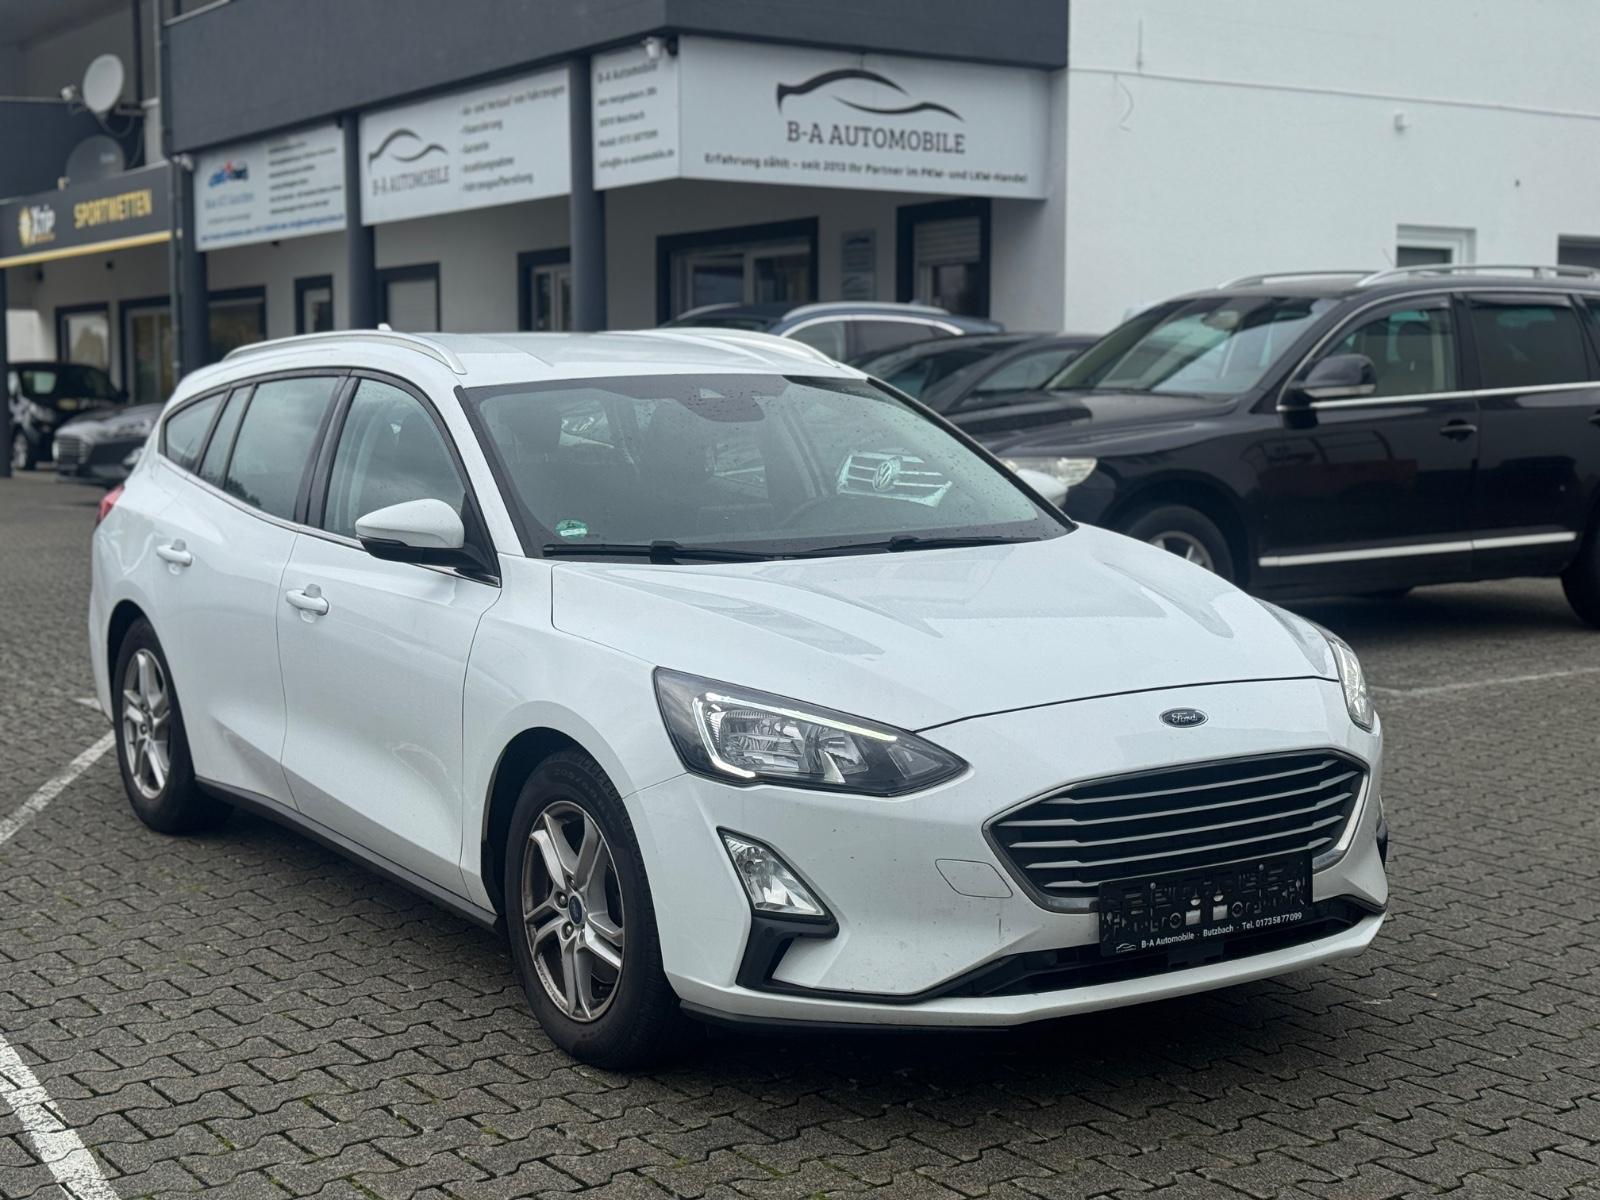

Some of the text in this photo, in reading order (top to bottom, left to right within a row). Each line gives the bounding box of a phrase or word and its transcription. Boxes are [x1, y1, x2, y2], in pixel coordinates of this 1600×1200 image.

[787, 121, 966, 155] B-A AUTOMOBILE
[389, 165, 450, 194] AUTOMOBILE
[704, 153, 761, 169] Erfahrung
[801, 159, 821, 171] seit
[865, 164, 904, 175] Partner
[906, 166, 919, 177] im
[949, 170, 967, 180] und
[73, 190, 152, 230] SPORTWETTEN
[1141, 912, 1302, 949] B-A Automobile Butzbach Tel. 01735877099
